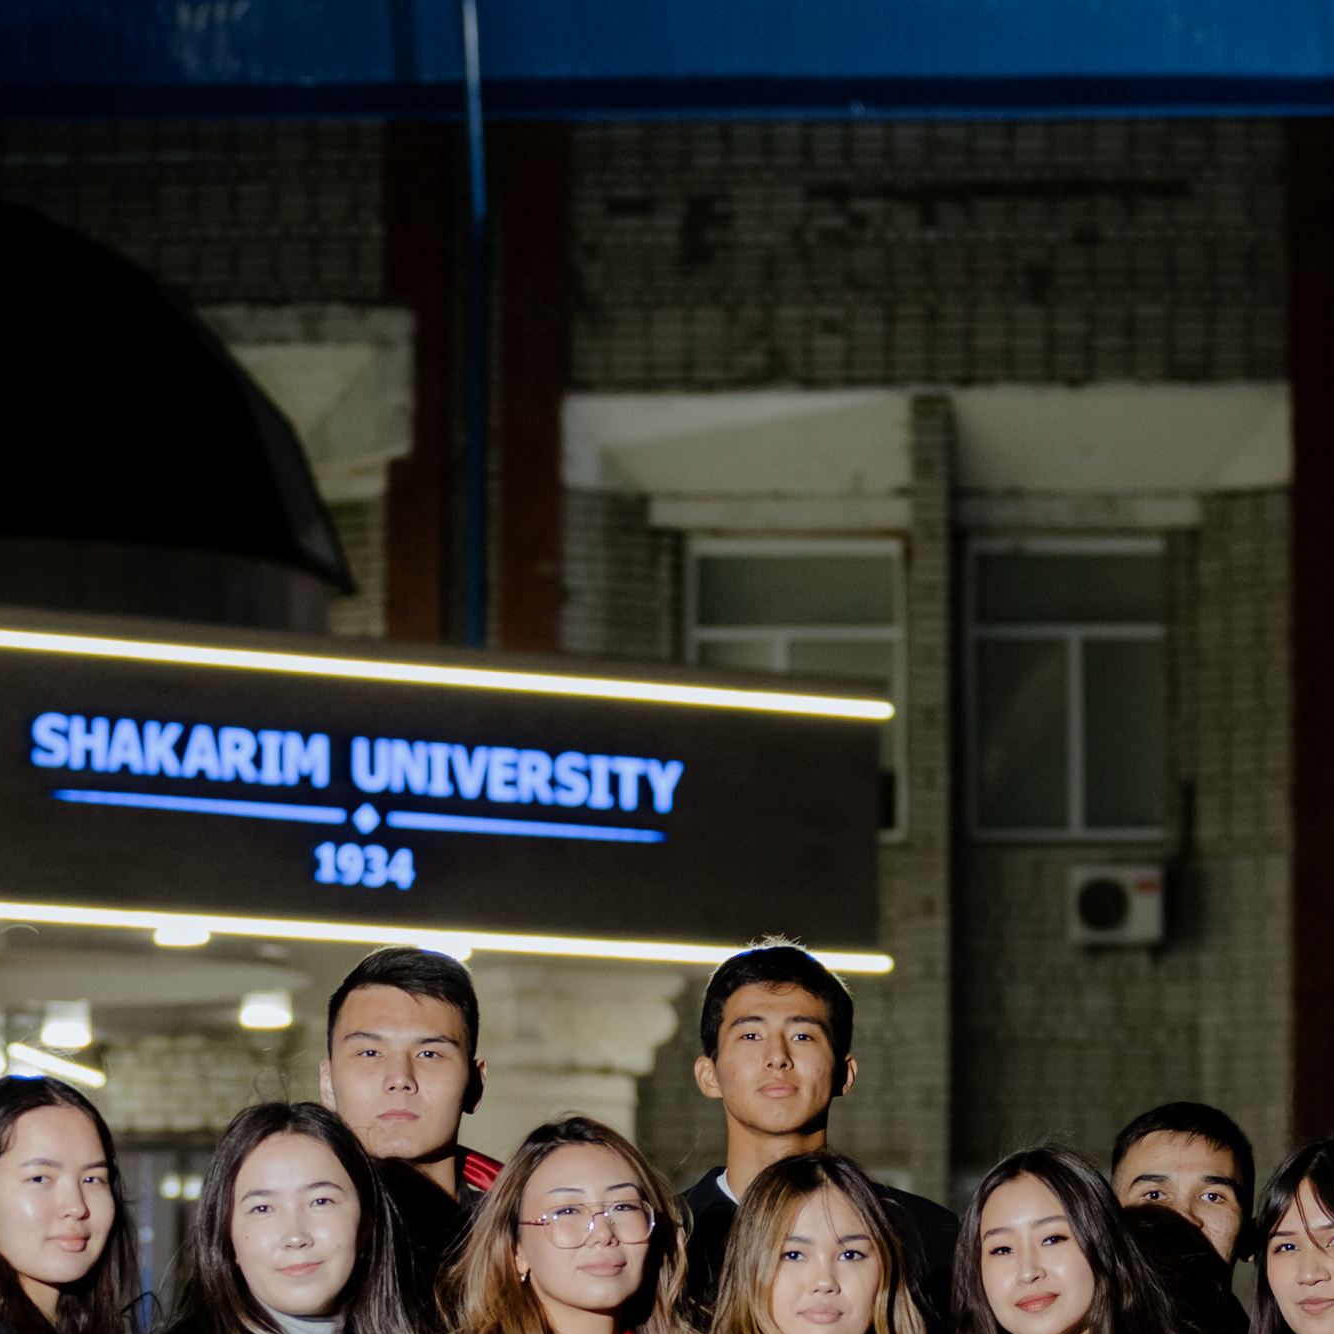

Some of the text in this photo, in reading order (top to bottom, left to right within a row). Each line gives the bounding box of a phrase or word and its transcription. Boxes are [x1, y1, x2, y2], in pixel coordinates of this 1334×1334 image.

[31, 712, 683, 813] SHAKARIM UNIVERSITY
[314, 842, 415, 890] 1934
